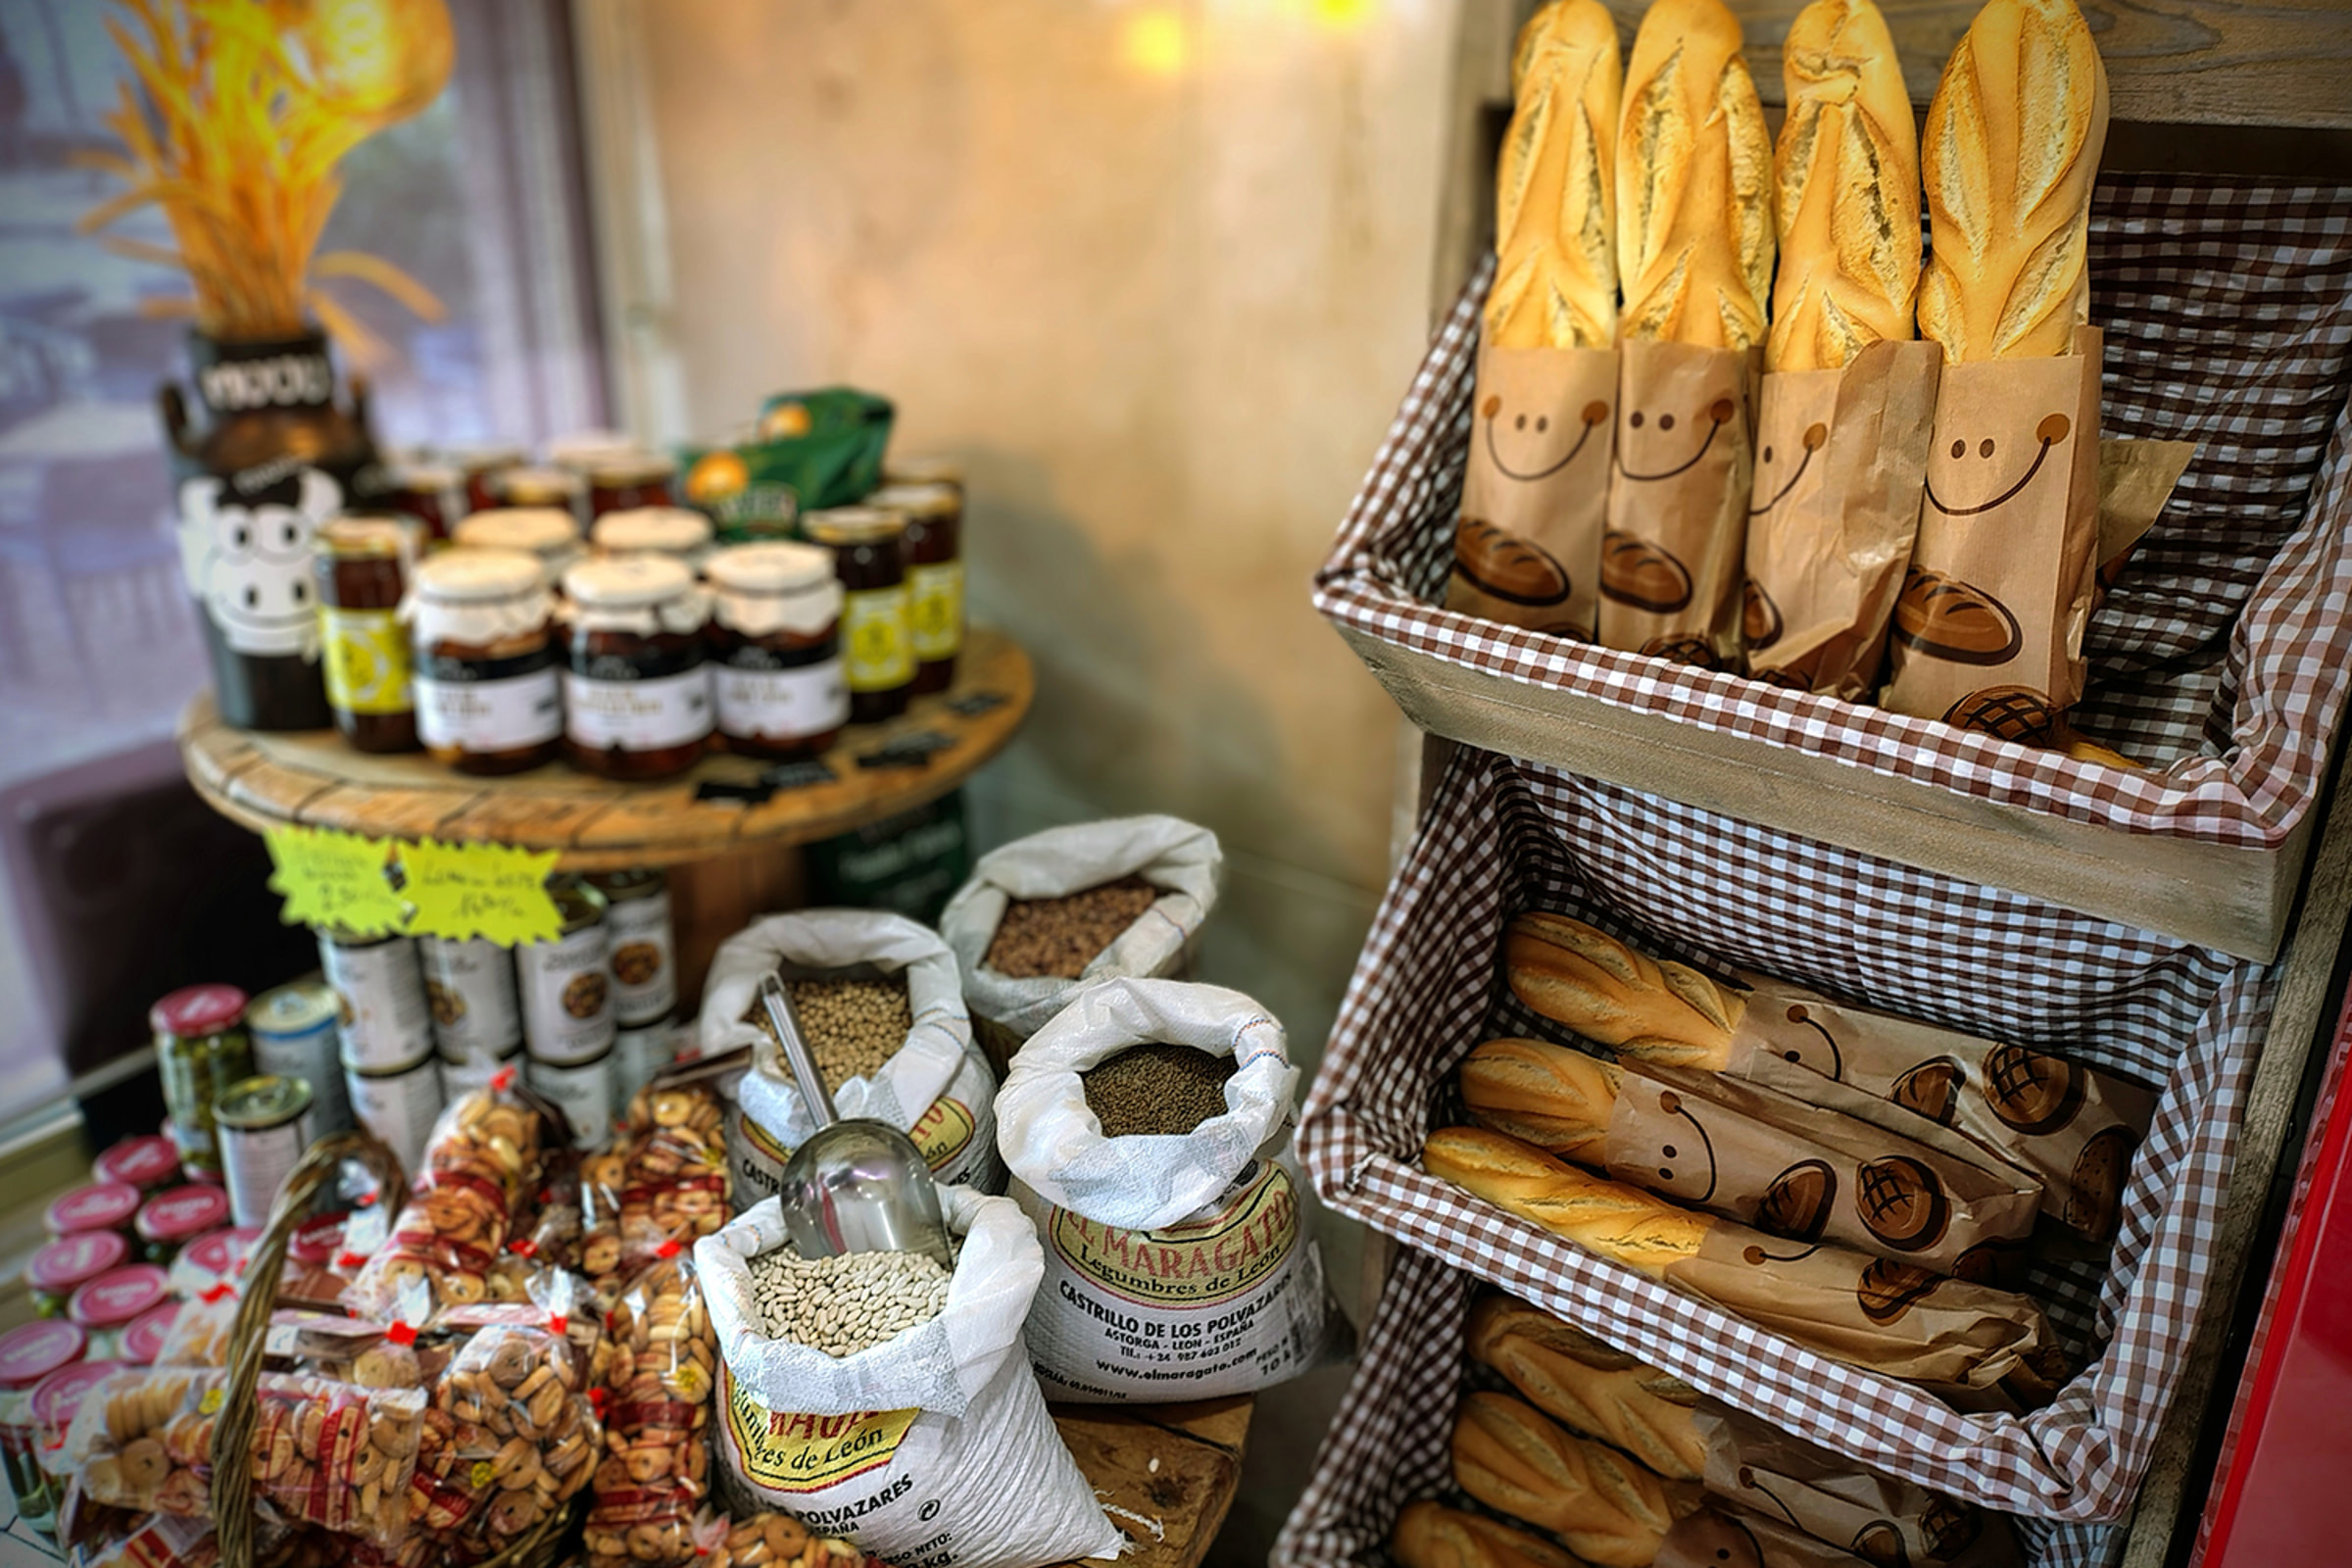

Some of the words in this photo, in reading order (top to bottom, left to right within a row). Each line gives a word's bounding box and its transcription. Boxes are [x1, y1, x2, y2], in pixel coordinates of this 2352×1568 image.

[1102, 1189, 1291, 1279] MARAGATO
[1080, 1243, 1198, 1295] Legumbres
[1205, 1277, 1230, 1292] de
[1237, 1245, 1280, 1282] León
[1059, 1279, 1139, 1334] CASTRILLO
[1145, 1321, 1165, 1338] DE
[1171, 1322, 1202, 1339] LOS
[1104, 1328, 1159, 1349] ASTORGA
[1213, 1319, 1254, 1345] ESPAÑA
[1096, 1347, 1257, 1381] www.elmaragato.com
[1177, 1350, 1198, 1362] 987
[791, 1446, 818, 1471] de
[824, 1428, 883, 1465] León
[914, 1532, 953, 1556] NETO:
